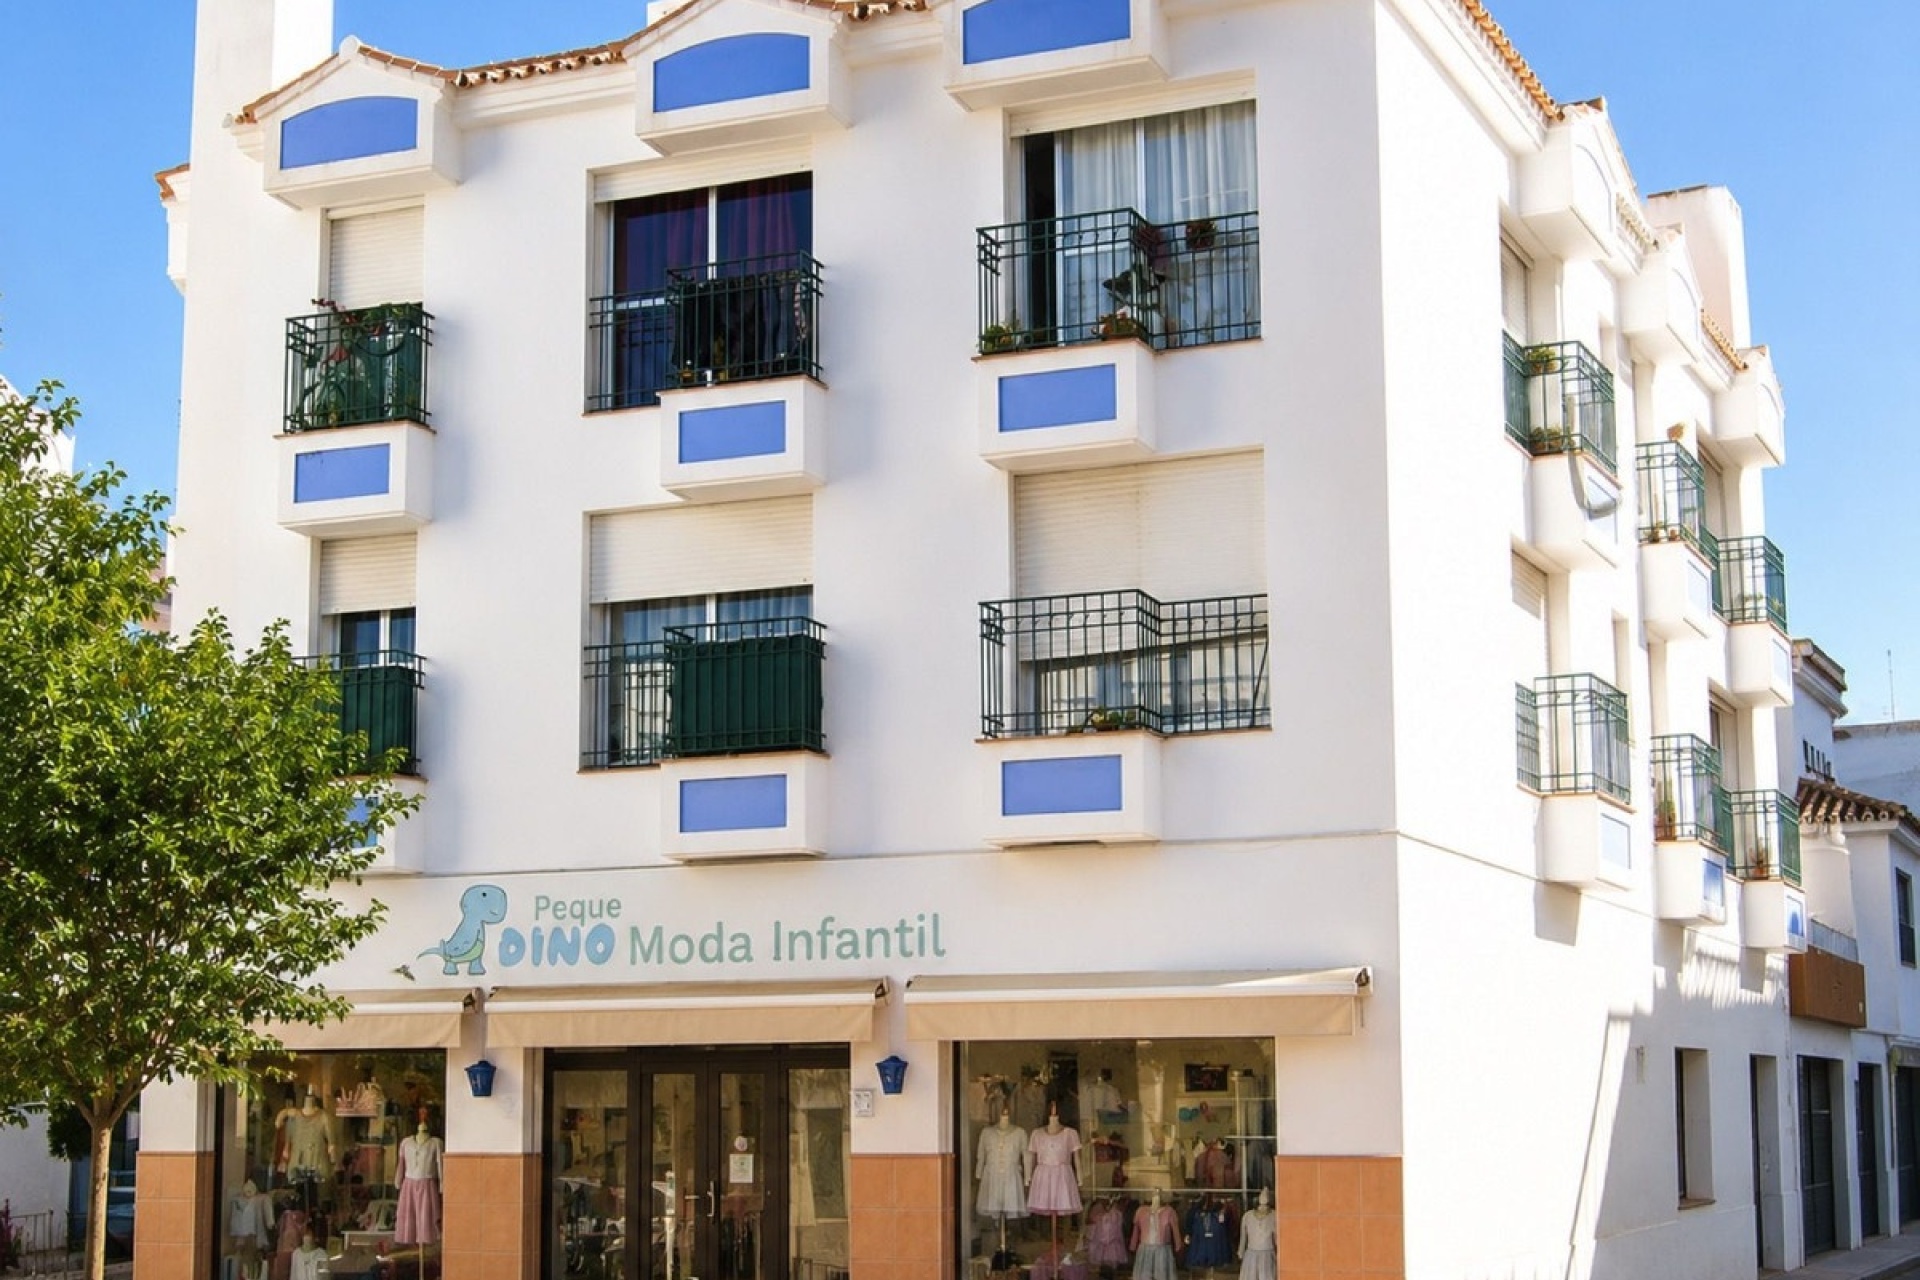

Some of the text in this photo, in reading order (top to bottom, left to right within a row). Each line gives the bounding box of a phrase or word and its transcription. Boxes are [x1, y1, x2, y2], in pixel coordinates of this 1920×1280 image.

[535, 895, 622, 927] Peque
[498, 913, 946, 967] DINO Moda Infantil
